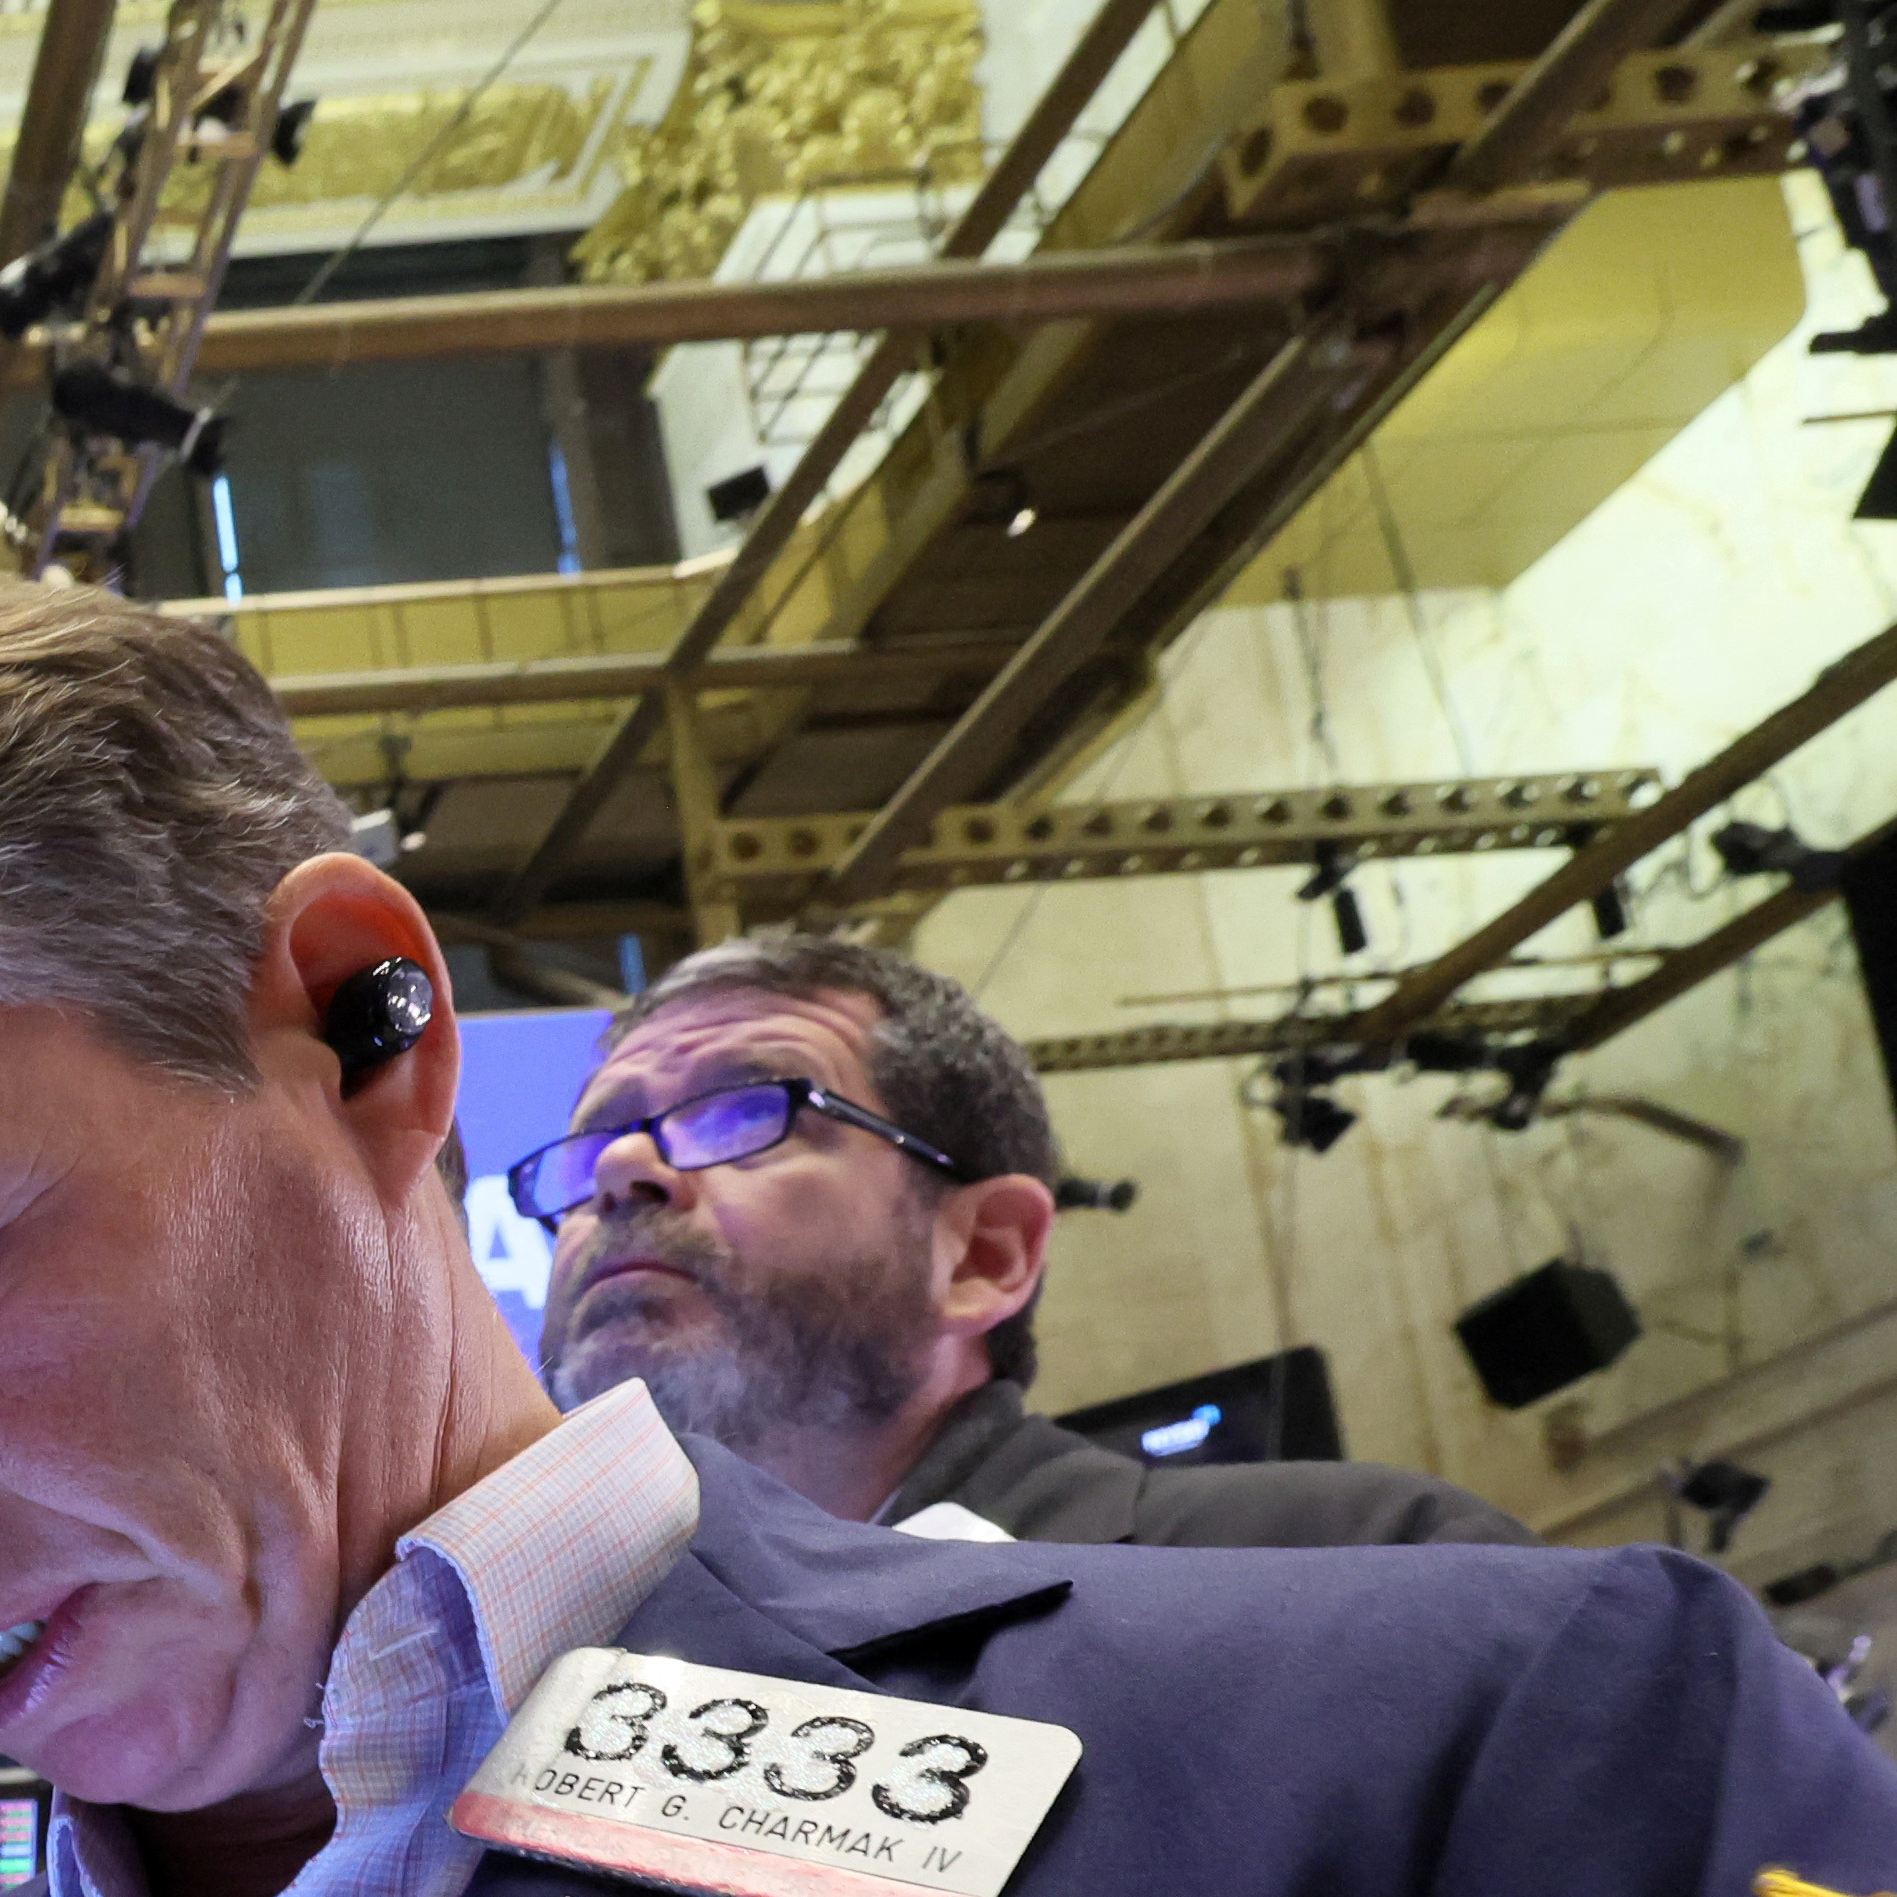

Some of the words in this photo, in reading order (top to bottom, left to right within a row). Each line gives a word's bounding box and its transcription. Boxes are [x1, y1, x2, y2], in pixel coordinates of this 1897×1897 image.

[563, 1682, 989, 1826] 3333
[661, 1794, 692, 1821] G.
[717, 1806, 905, 1863] CHARMAK
[922, 1845, 962, 1874] IV
